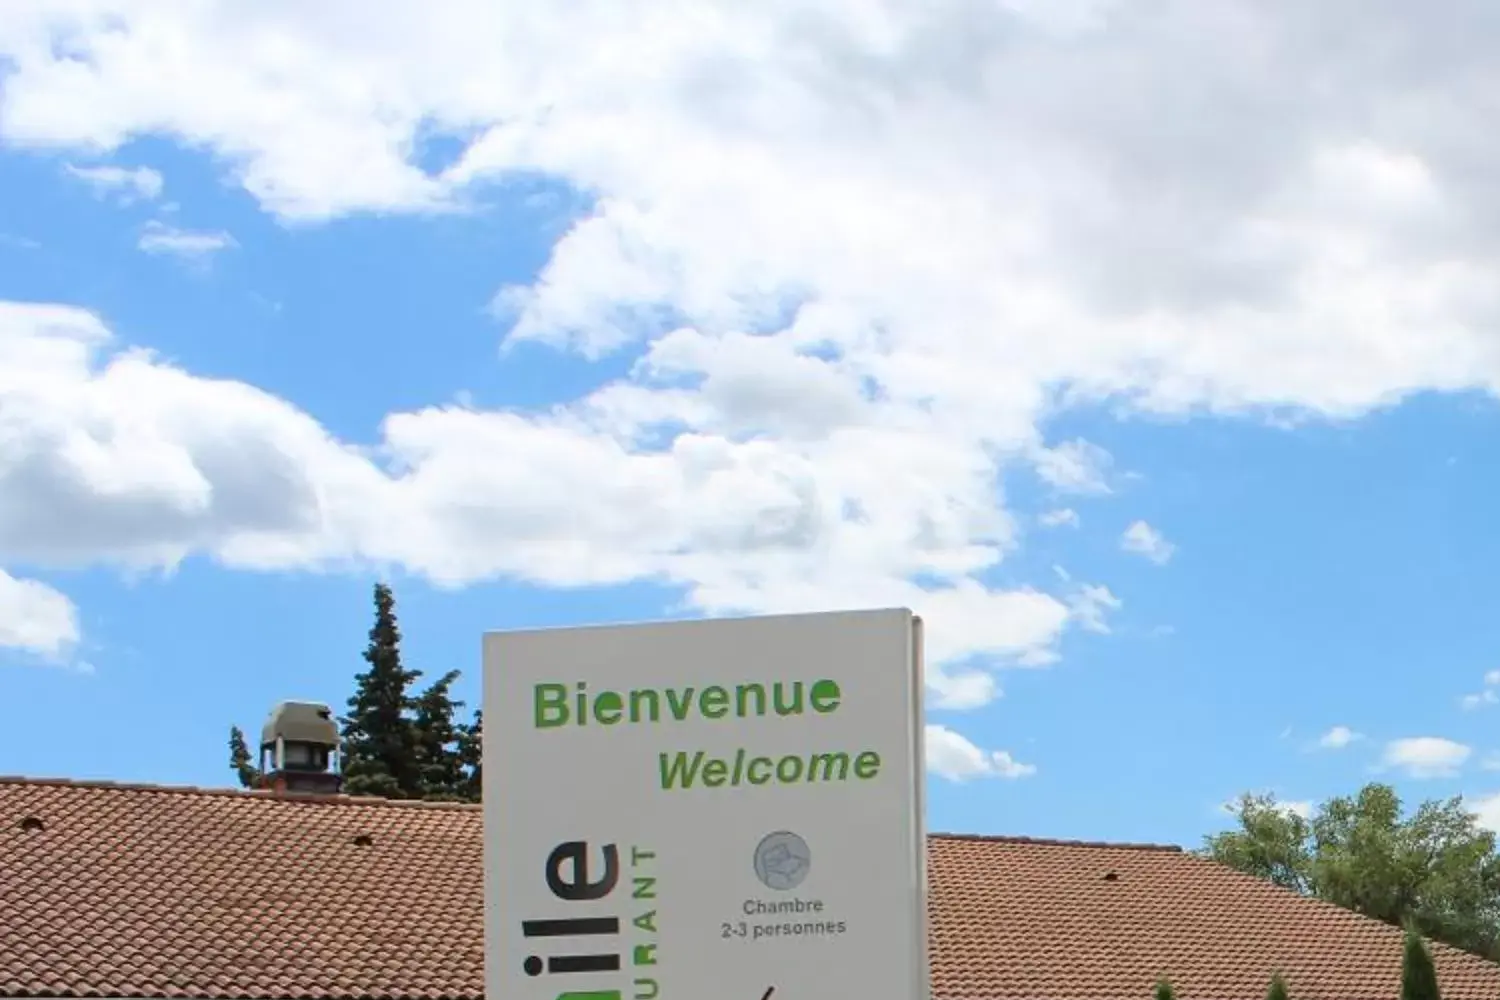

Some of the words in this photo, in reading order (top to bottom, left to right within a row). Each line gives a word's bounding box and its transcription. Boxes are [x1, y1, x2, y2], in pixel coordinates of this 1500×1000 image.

[533, 679, 841, 728] Bienvenue
[659, 749, 881, 790] Welcome
[743, 898, 824, 915] Chambre
[721, 923, 748, 939] 2-3
[753, 920, 847, 938] personnes
